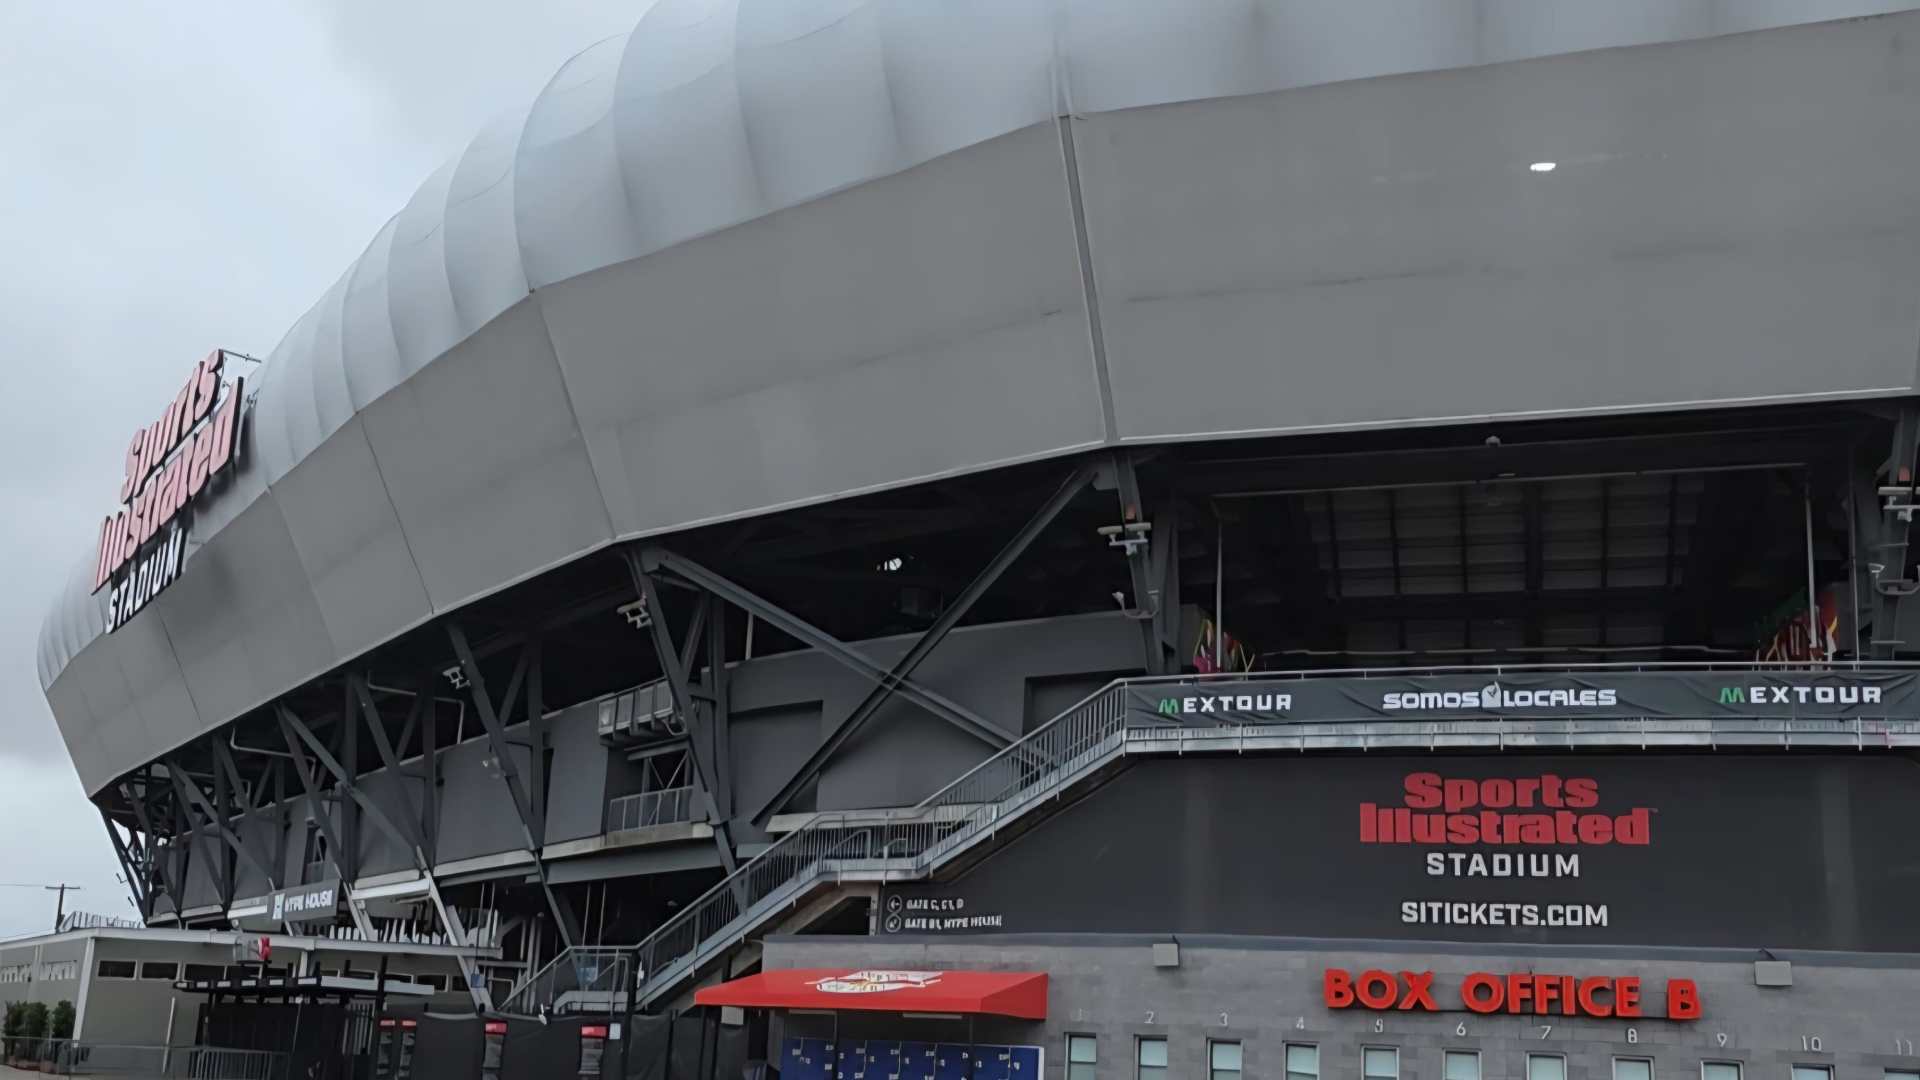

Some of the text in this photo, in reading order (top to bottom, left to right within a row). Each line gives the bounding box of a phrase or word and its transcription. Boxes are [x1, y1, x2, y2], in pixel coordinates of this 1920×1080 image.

[106, 528, 187, 633] STADIUM
[1158, 694, 1292, 713] MEXTOUR
[1382, 688, 1617, 710] SOMOS LOCALES
[1719, 686, 1881, 704] MEXTOUR
[1404, 773, 1599, 812] Sports
[1359, 803, 1650, 845] Illustrated
[1426, 852, 1580, 877] STADIUM
[1401, 901, 1608, 927] SITICKETS.COM
[1324, 968, 1701, 1019] BOX OFFICE B
[1144, 1011, 1154, 1025] 2
[1456, 1022, 1466, 1037] 6
[1540, 1025, 1552, 1040] 7
[1626, 1028, 1638, 1044] 8
[1716, 1032, 1728, 1048] 9
[1801, 1035, 1822, 1052] 10
[1895, 1039, 1913, 1056] 11
